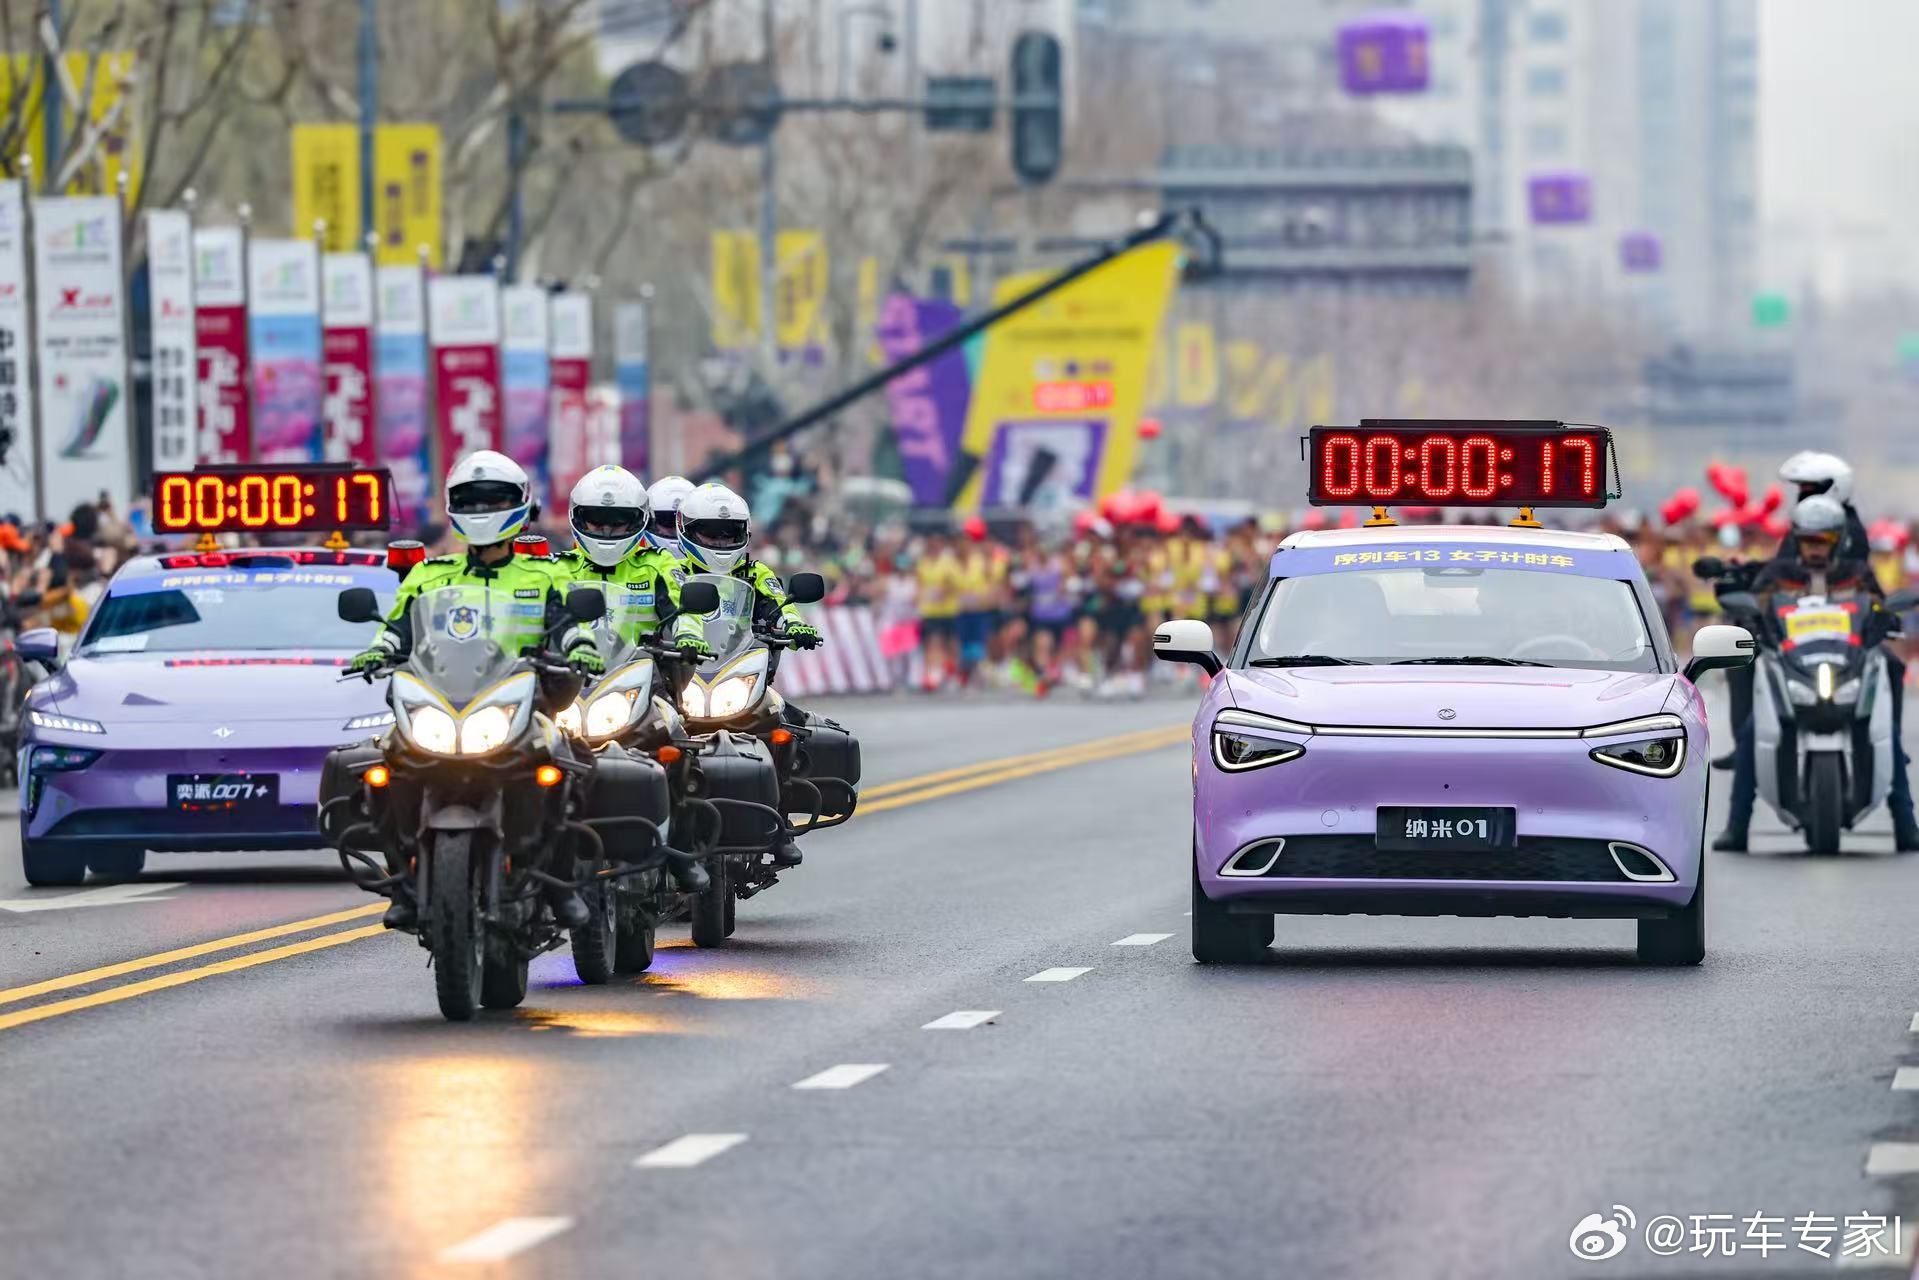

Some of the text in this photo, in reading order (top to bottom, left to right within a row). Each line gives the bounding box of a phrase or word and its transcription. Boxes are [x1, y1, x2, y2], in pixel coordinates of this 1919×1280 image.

[1325, 436, 1594, 498] 00:00:17
[162, 474, 380, 527] 00:00:17
[1333, 549, 1576, 567] 序列车13 女子计时车
[1405, 818, 1487, 839] 纳米01
